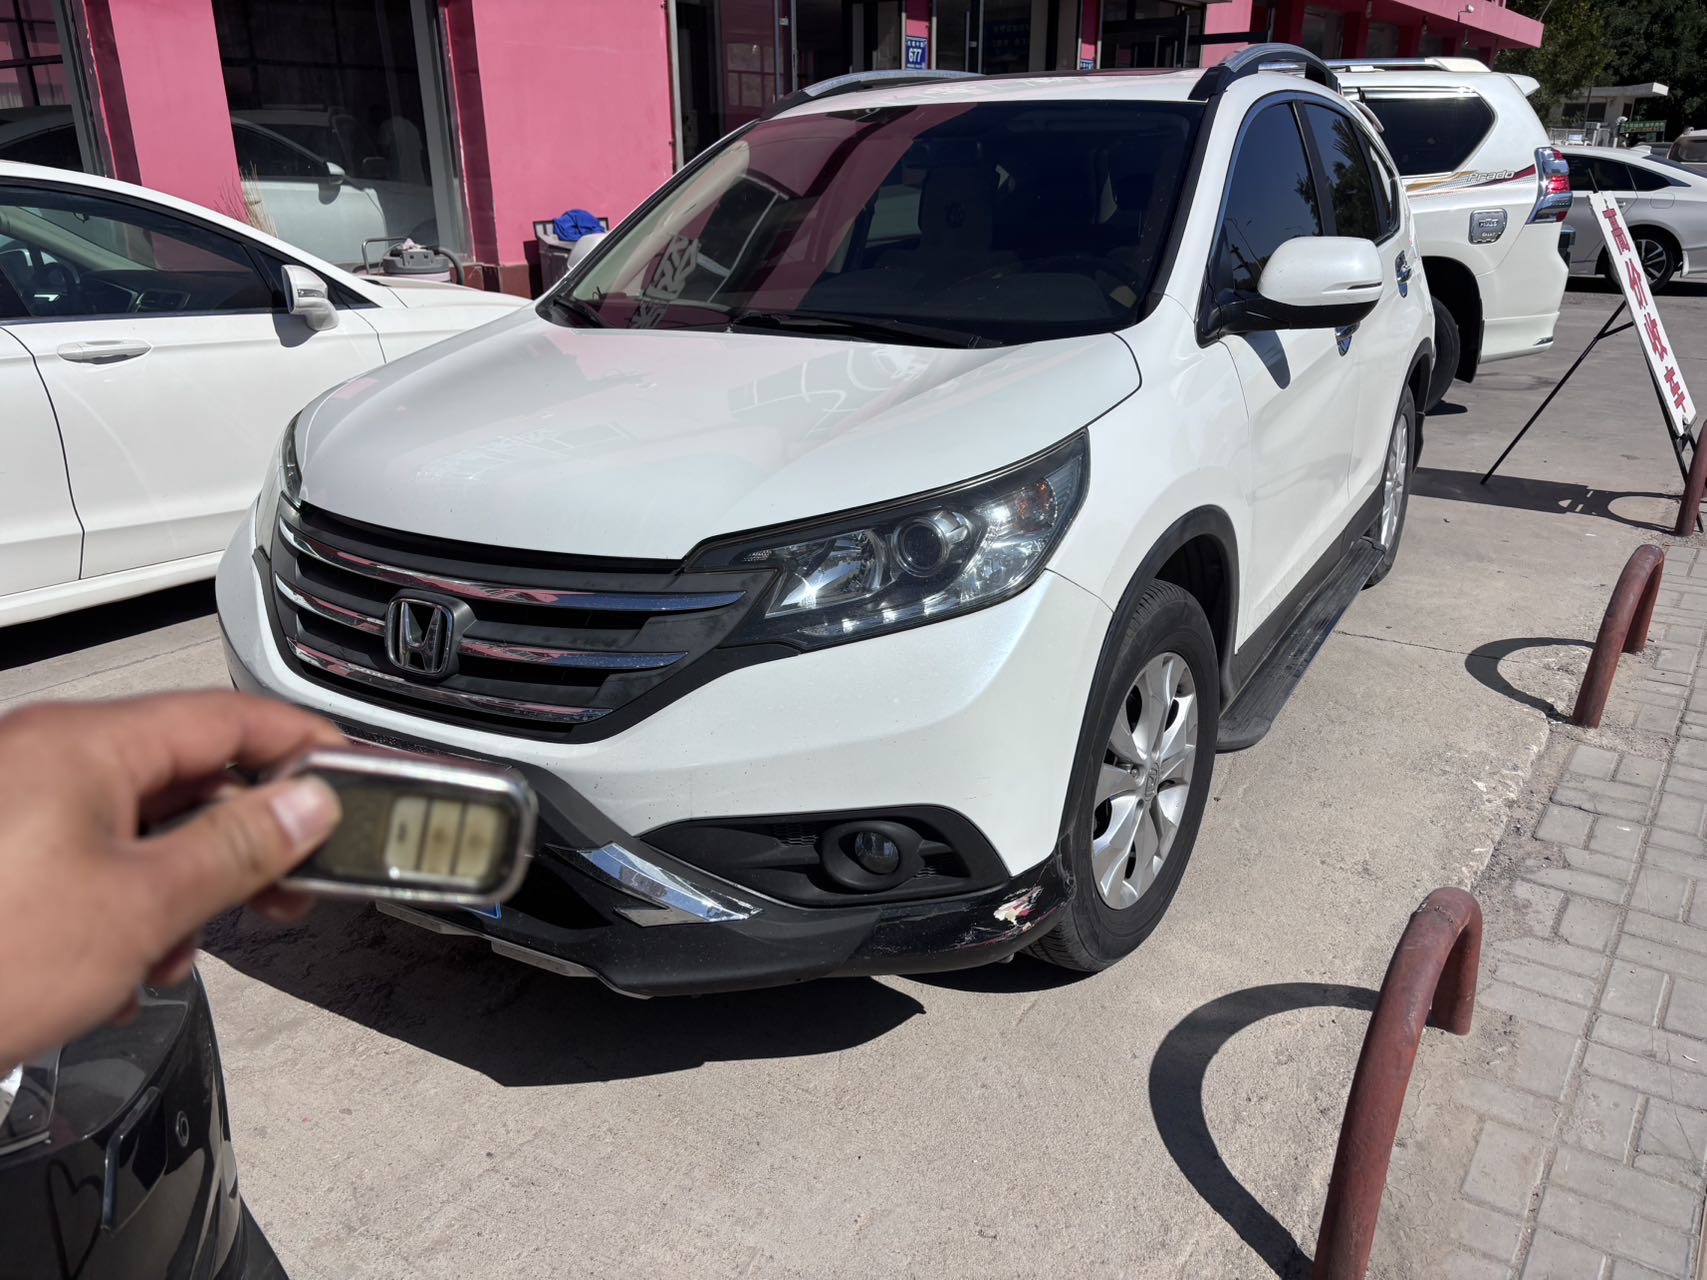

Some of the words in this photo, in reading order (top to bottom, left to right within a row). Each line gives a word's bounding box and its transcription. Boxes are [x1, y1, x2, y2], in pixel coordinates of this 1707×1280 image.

[909, 48, 922, 62] 677
[1467, 170, 1515, 182] Prado
[1602, 199, 1686, 413] 高价收车
